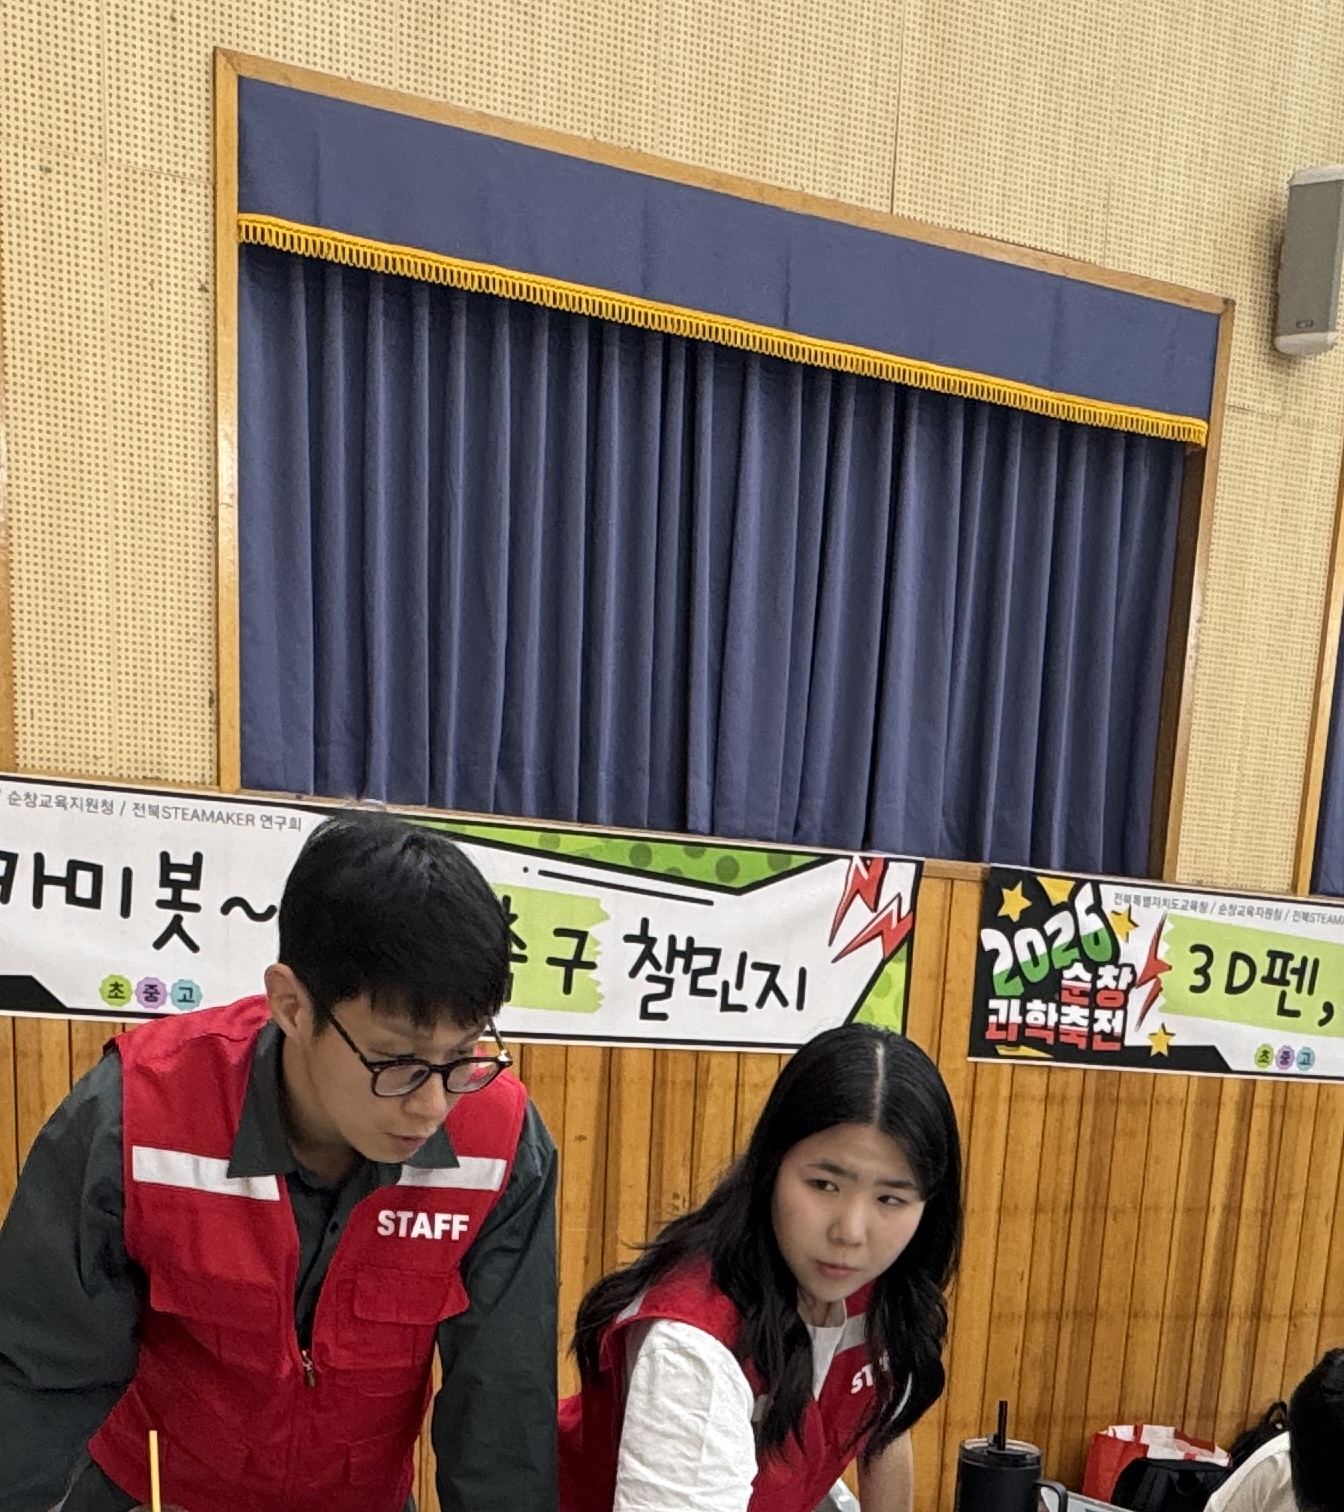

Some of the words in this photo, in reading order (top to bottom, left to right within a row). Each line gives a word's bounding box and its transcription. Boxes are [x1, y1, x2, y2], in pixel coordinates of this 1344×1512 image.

[7, 790, 115, 816] 순창교육지원청
[131, 801, 256, 828] 전북STEAMAKER
[260, 813, 303, 832] 연구회
[981, 883, 1115, 998] 2026
[107, 981, 126, 1002] 초
[141, 982, 161, 1002] 중
[177, 986, 197, 1005] 고
[623, 918, 807, 1021] 챌린지
[1061, 962, 1135, 1009] 순창
[1188, 943, 1337, 1029] 3D펜,
[987, 998, 1126, 1053] 과학축전
[377, 1210, 470, 1240] STAFF
